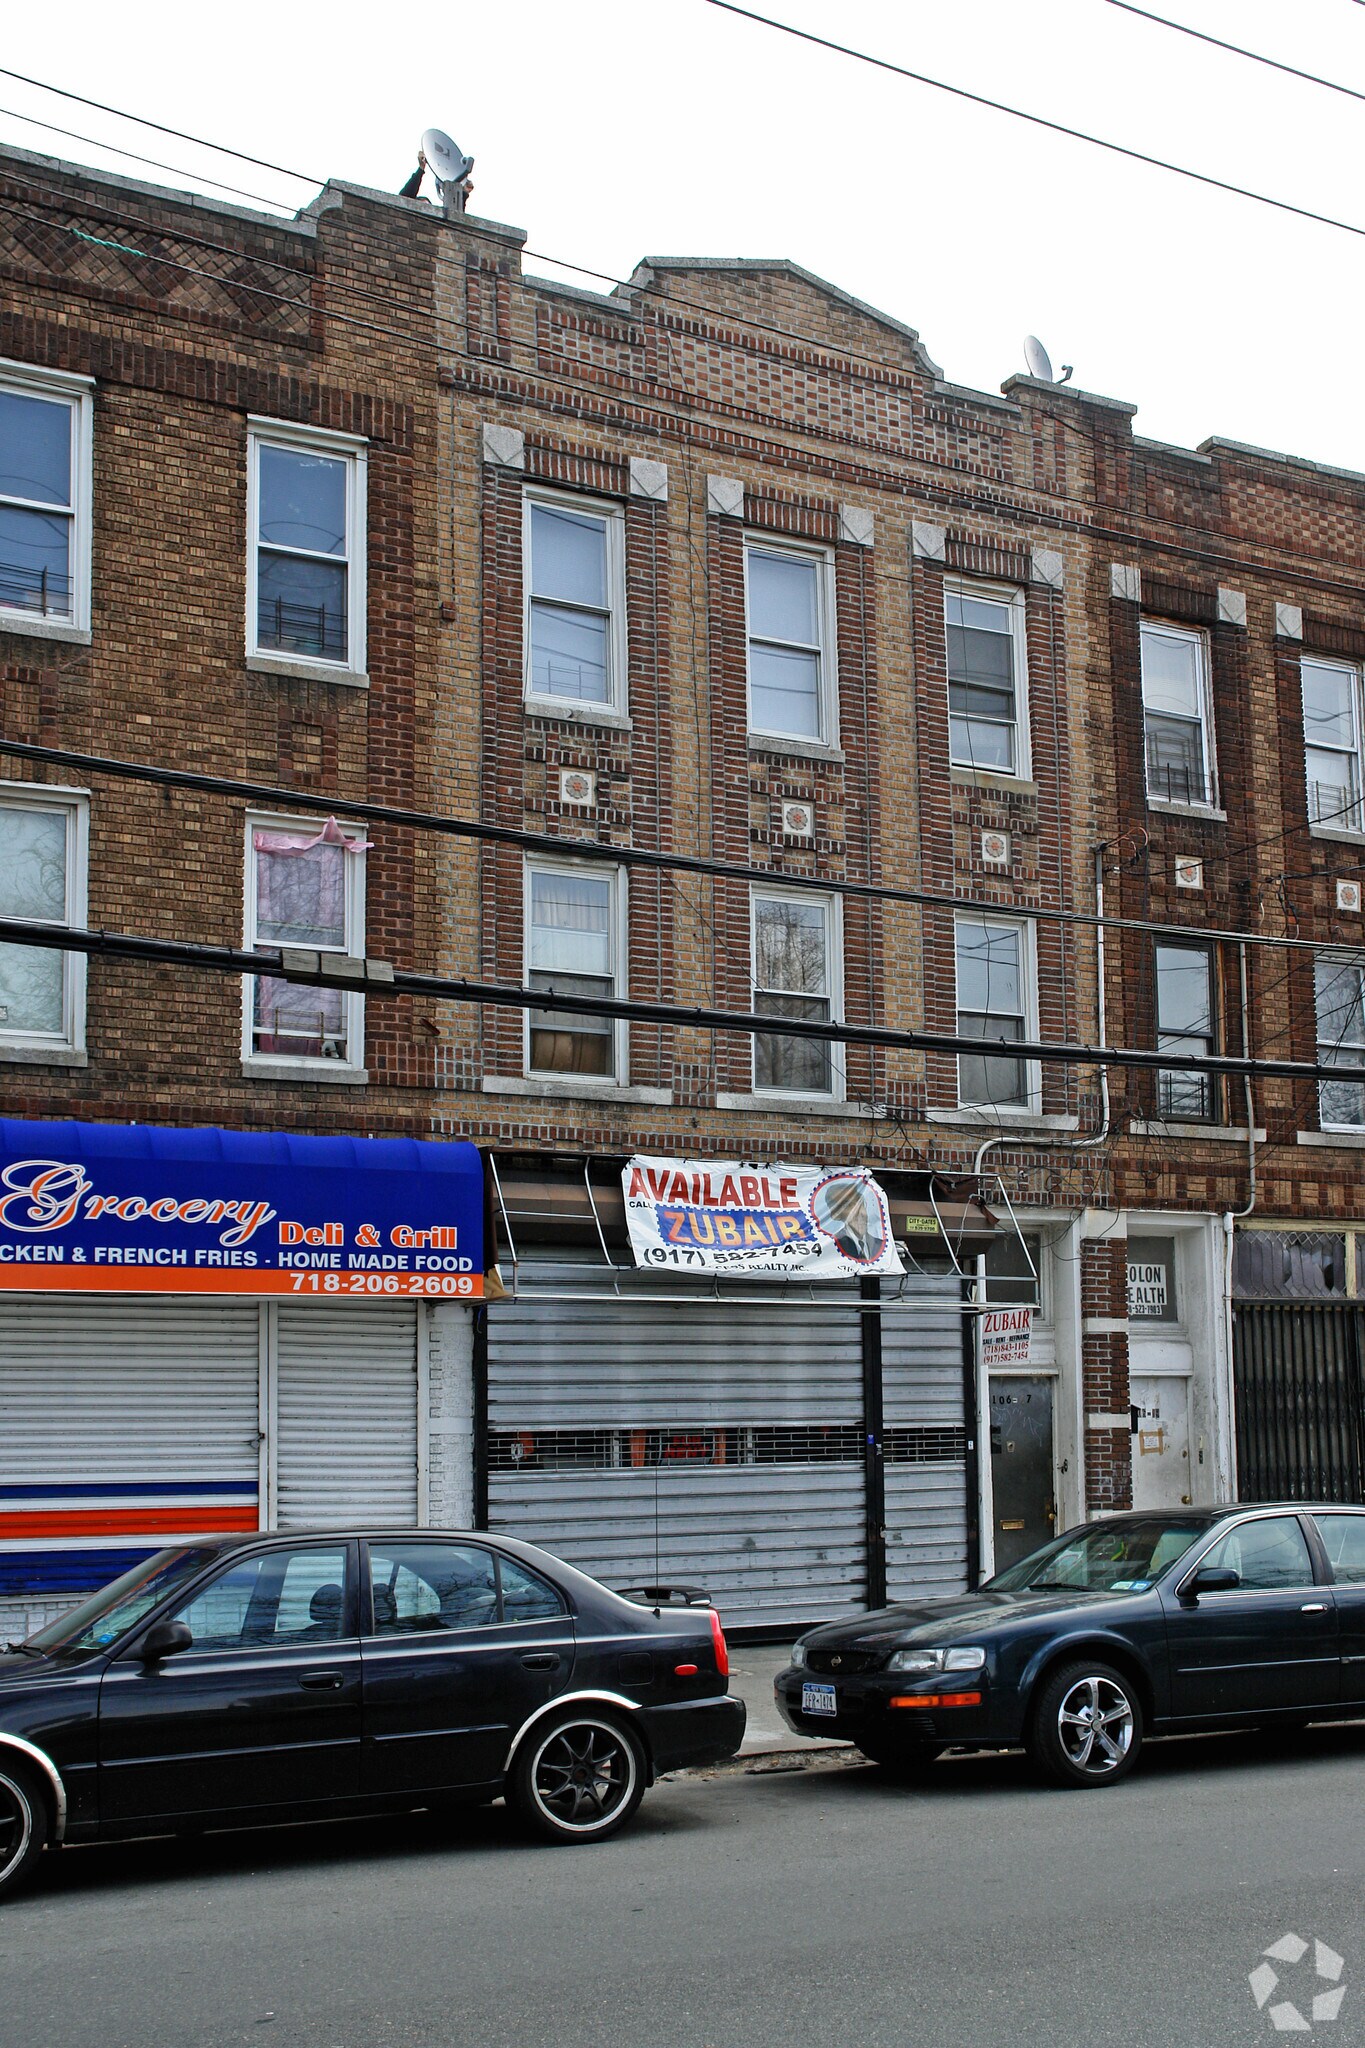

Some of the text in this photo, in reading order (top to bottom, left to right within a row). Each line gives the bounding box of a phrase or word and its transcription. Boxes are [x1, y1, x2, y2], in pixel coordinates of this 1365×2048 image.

[628, 1167, 800, 1209] AVAILABLE
[0, 1159, 277, 1247] Grocery
[629, 1200, 652, 1210] CALL
[279, 1221, 458, 1250] Deli & Grill
[663, 1211, 805, 1246] ZUBAIR
[72, 1247, 87, 1263] &
[94, 1247, 187, 1265] FRENCH
[195, 1250, 258, 1267] FRIES
[278, 1252, 342, 1268] HOME
[348, 1254, 409, 1270] MADE
[415, 1255, 473, 1272] FOOD
[643, 1248, 706, 1266] (917)
[290, 1273, 473, 1294] 718-206-2609
[1130, 1266, 1161, 1283] OLON
[984, 1310, 1030, 1333] ZUBAIR
